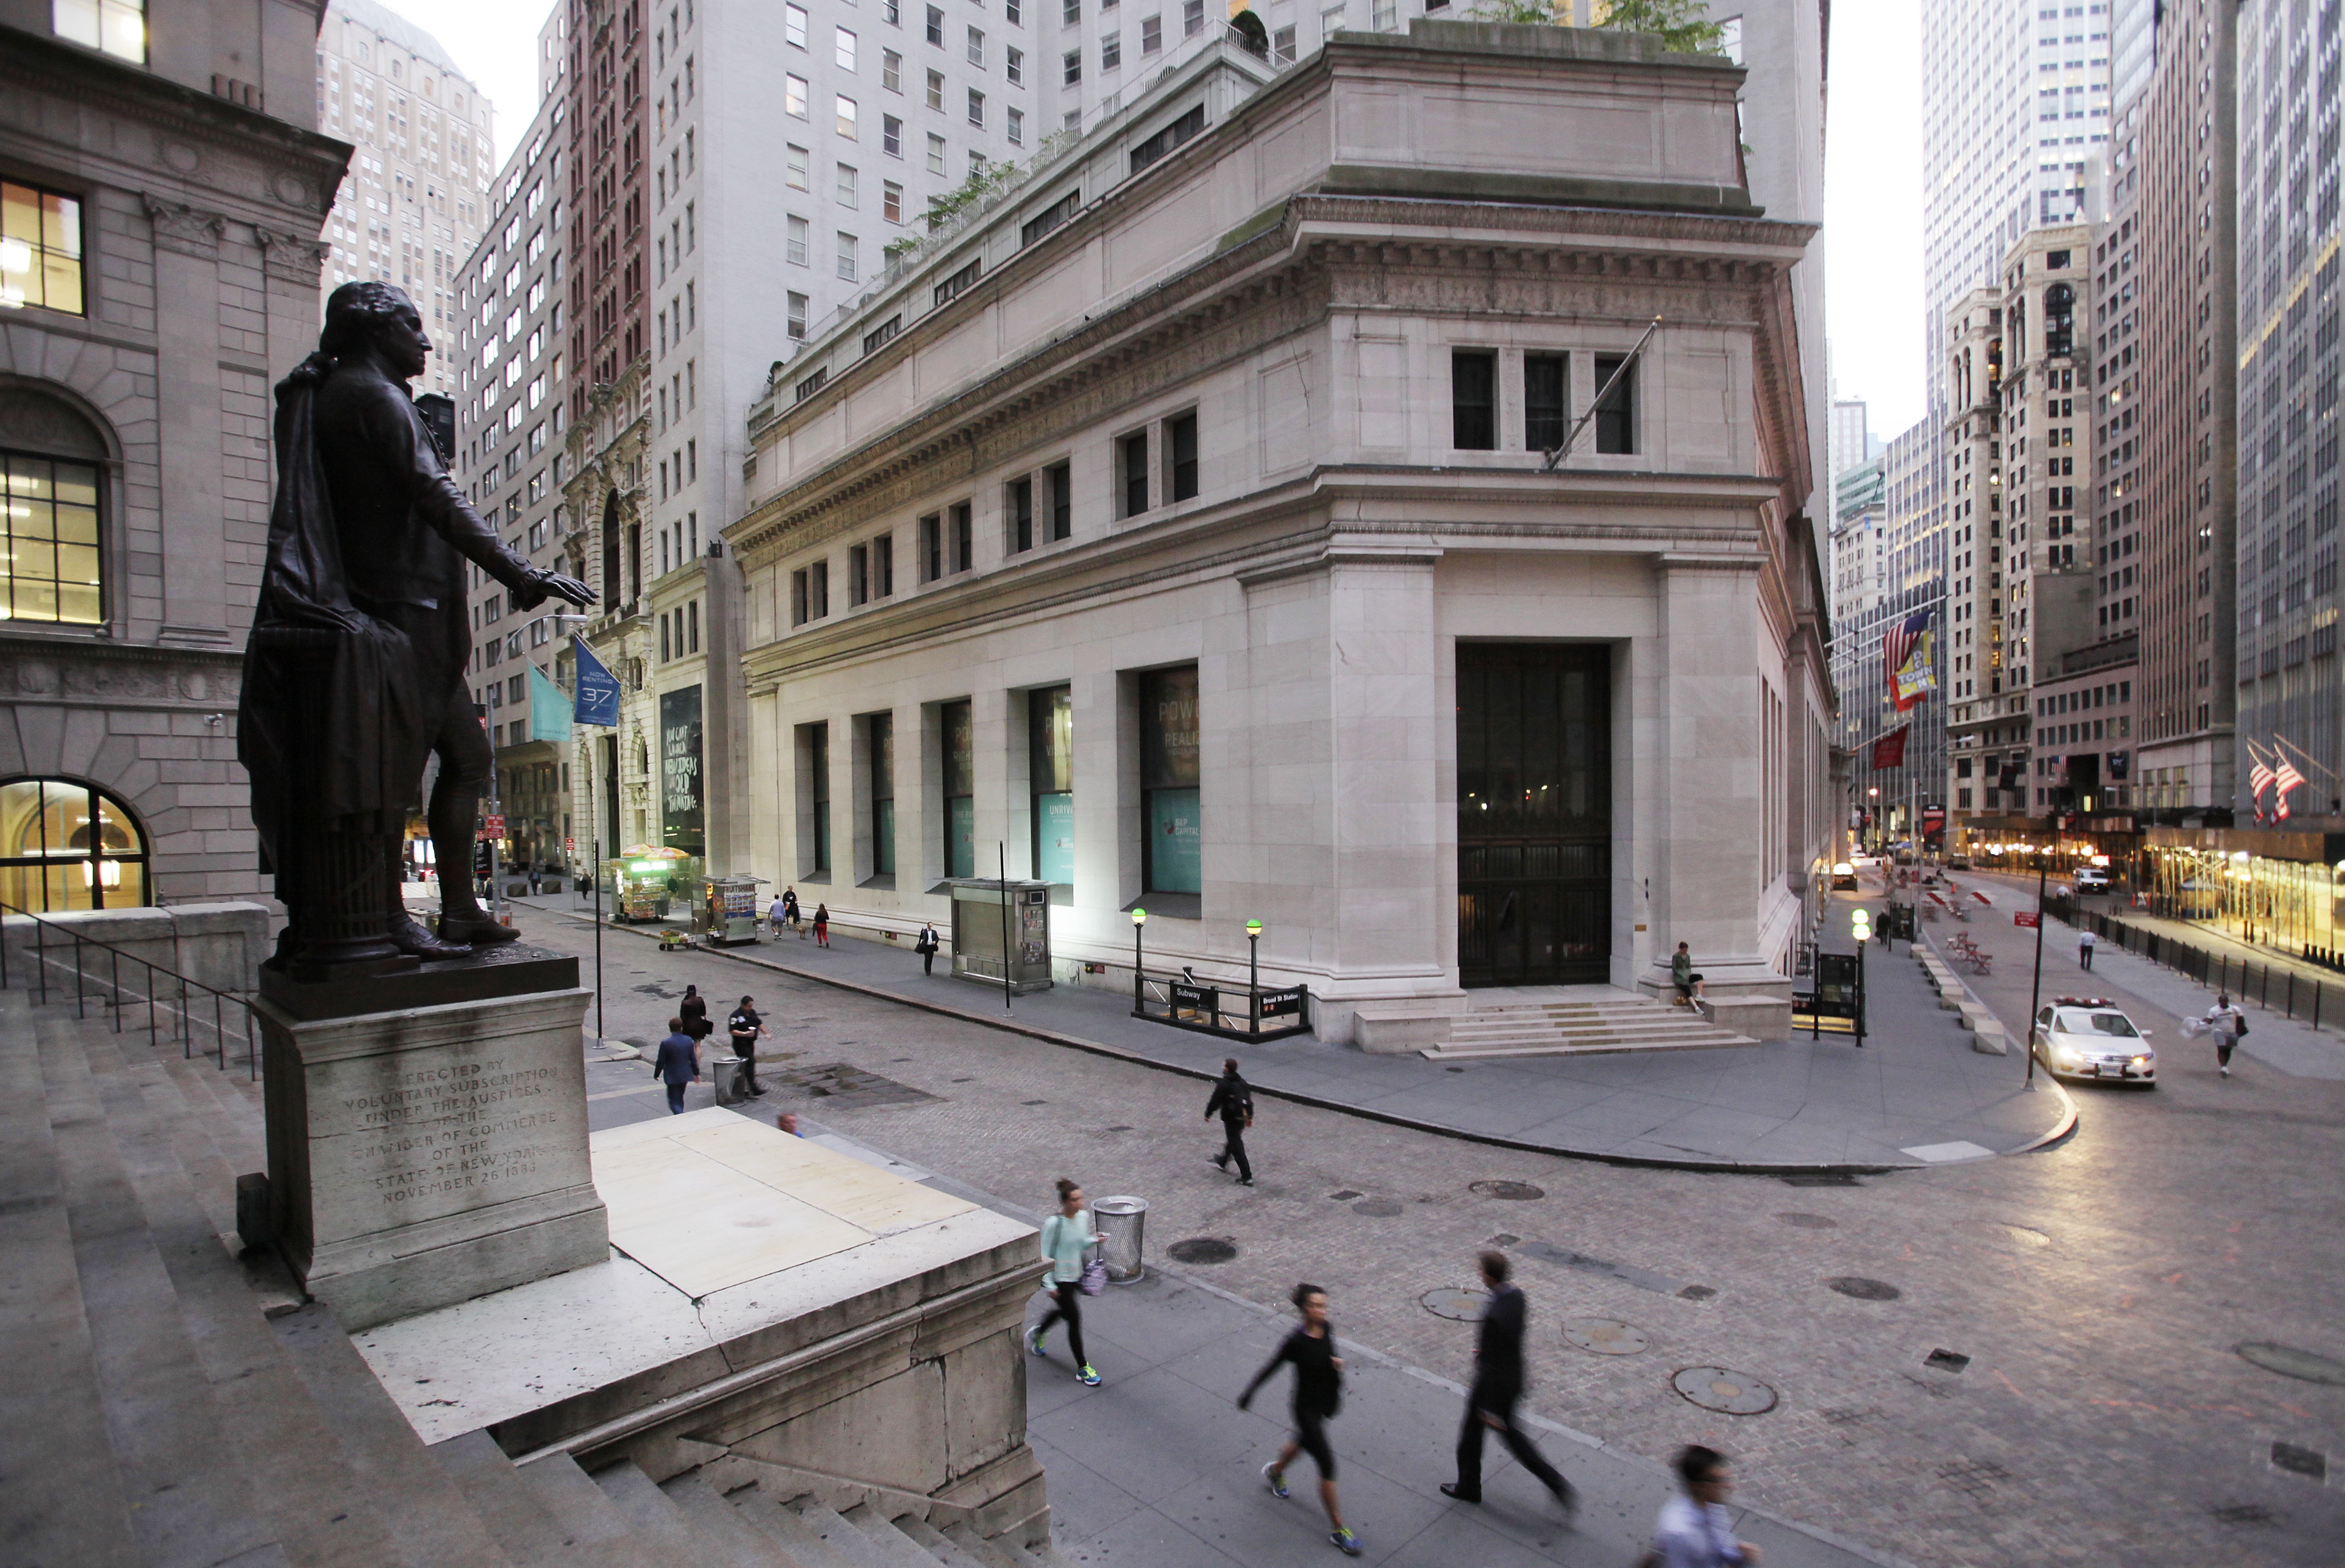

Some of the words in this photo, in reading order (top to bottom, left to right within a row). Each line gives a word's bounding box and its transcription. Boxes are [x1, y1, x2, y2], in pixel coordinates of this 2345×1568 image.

[582, 675, 613, 685] RENTING
[1897, 665, 1933, 684] TOWN
[582, 688, 612, 711] 37
[665, 758, 677, 775] NEW
[677, 757, 697, 777] IDEAS
[675, 773, 690, 794] OLD
[1176, 827, 1199, 836] CAPITAL
[1177, 988, 1201, 1001] Subway
[406, 1064, 481, 1085] ERECTED
[488, 1060, 504, 1071] BY
[344, 1085, 443, 1110] VOLUNTARY
[450, 1066, 557, 1094] SUBSCRIPTION
[366, 1105, 422, 1124] UNDER
[432, 1098, 461, 1113] THE
[442, 1130, 462, 1141] OF
[432, 1147, 452, 1161] OF
[460, 1140, 488, 1155] THE
[375, 1169, 426, 1189] STATE
[460, 1155, 498, 1172] NEW
[382, 1176, 475, 1205] NOVEMBER
[480, 1170, 499, 1183] 26
